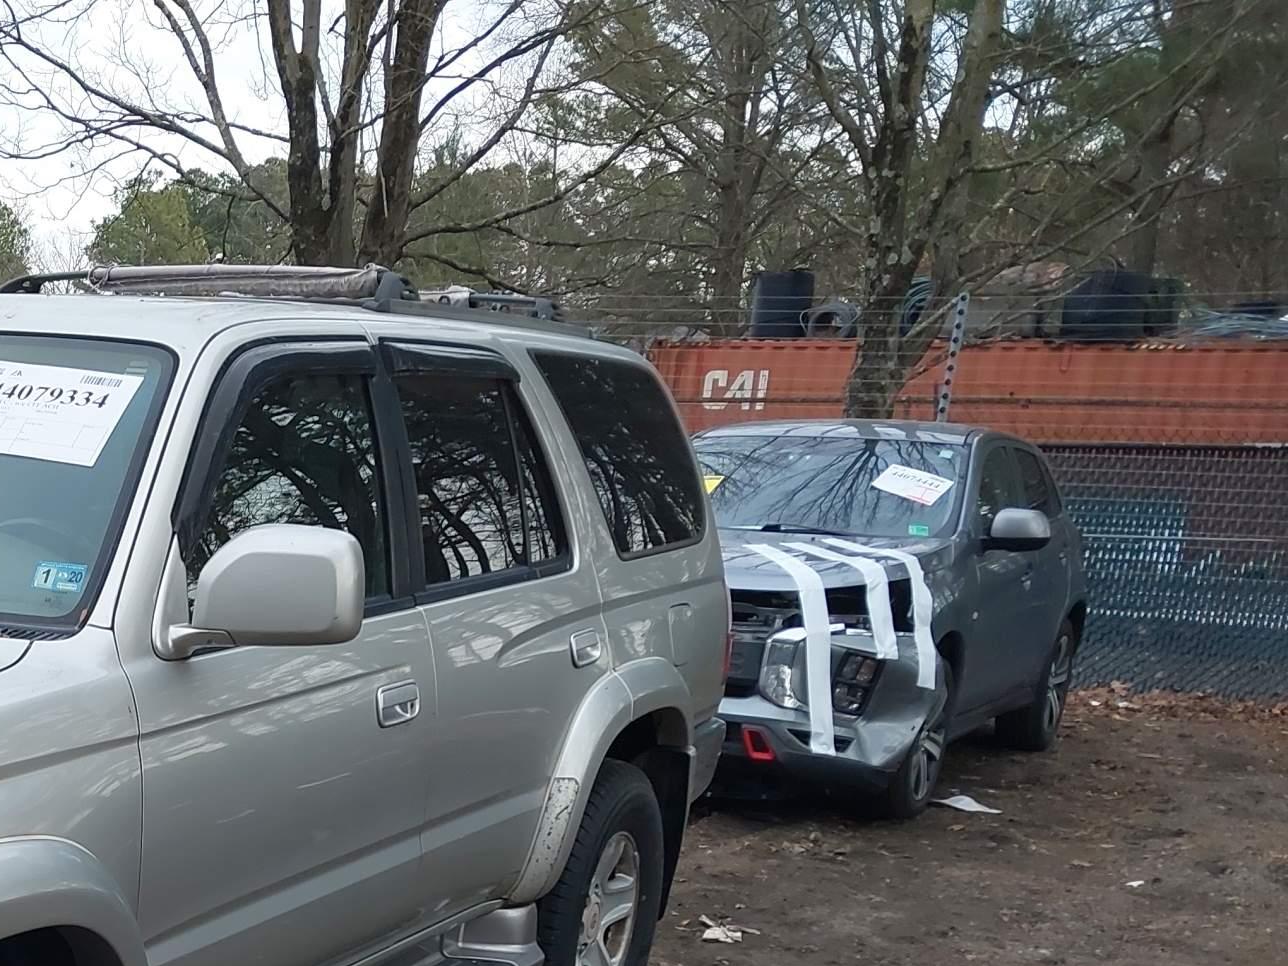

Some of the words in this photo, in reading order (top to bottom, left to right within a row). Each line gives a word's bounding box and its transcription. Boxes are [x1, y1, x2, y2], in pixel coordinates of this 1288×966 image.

[702, 369, 769, 410] CAI
[42, 568, 52, 584] 1
[68, 570, 83, 583] 20
